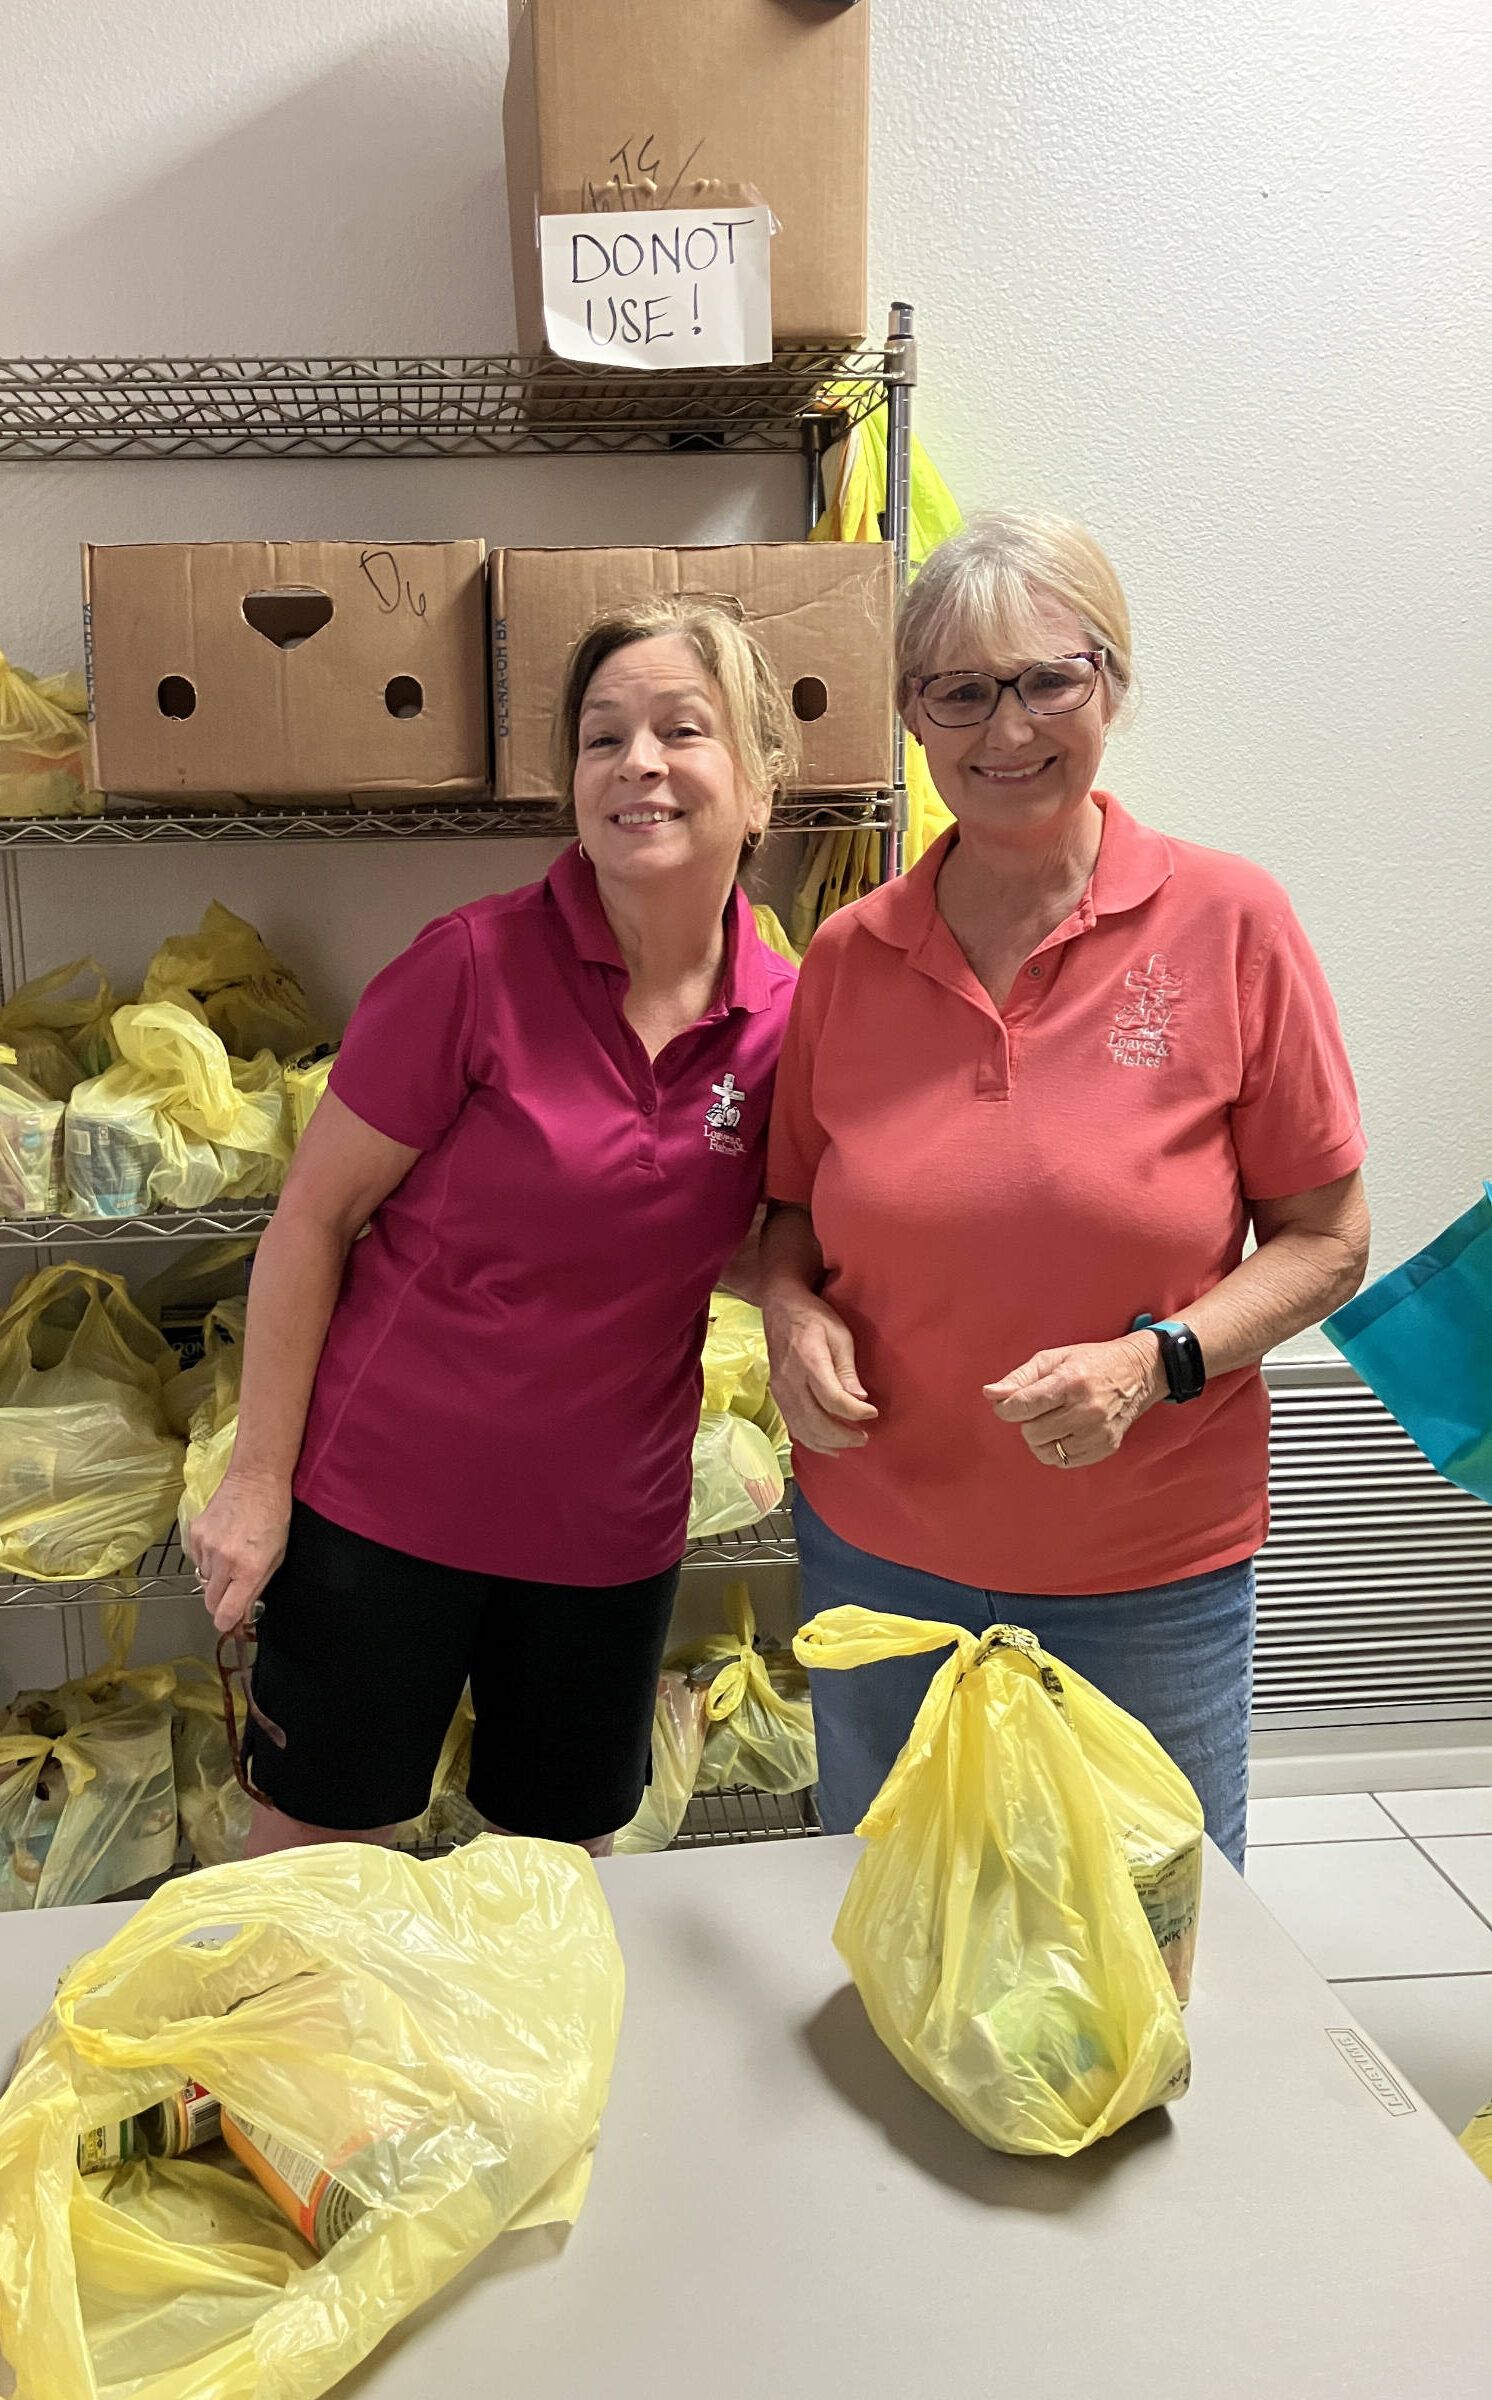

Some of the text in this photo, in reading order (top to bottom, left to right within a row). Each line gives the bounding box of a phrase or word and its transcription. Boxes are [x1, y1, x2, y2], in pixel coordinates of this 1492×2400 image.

[494, 617, 509, 641] BX
[1112, 1047, 1162, 1070] Fishes
[1335, 2034, 1405, 2109] LIFETIME
